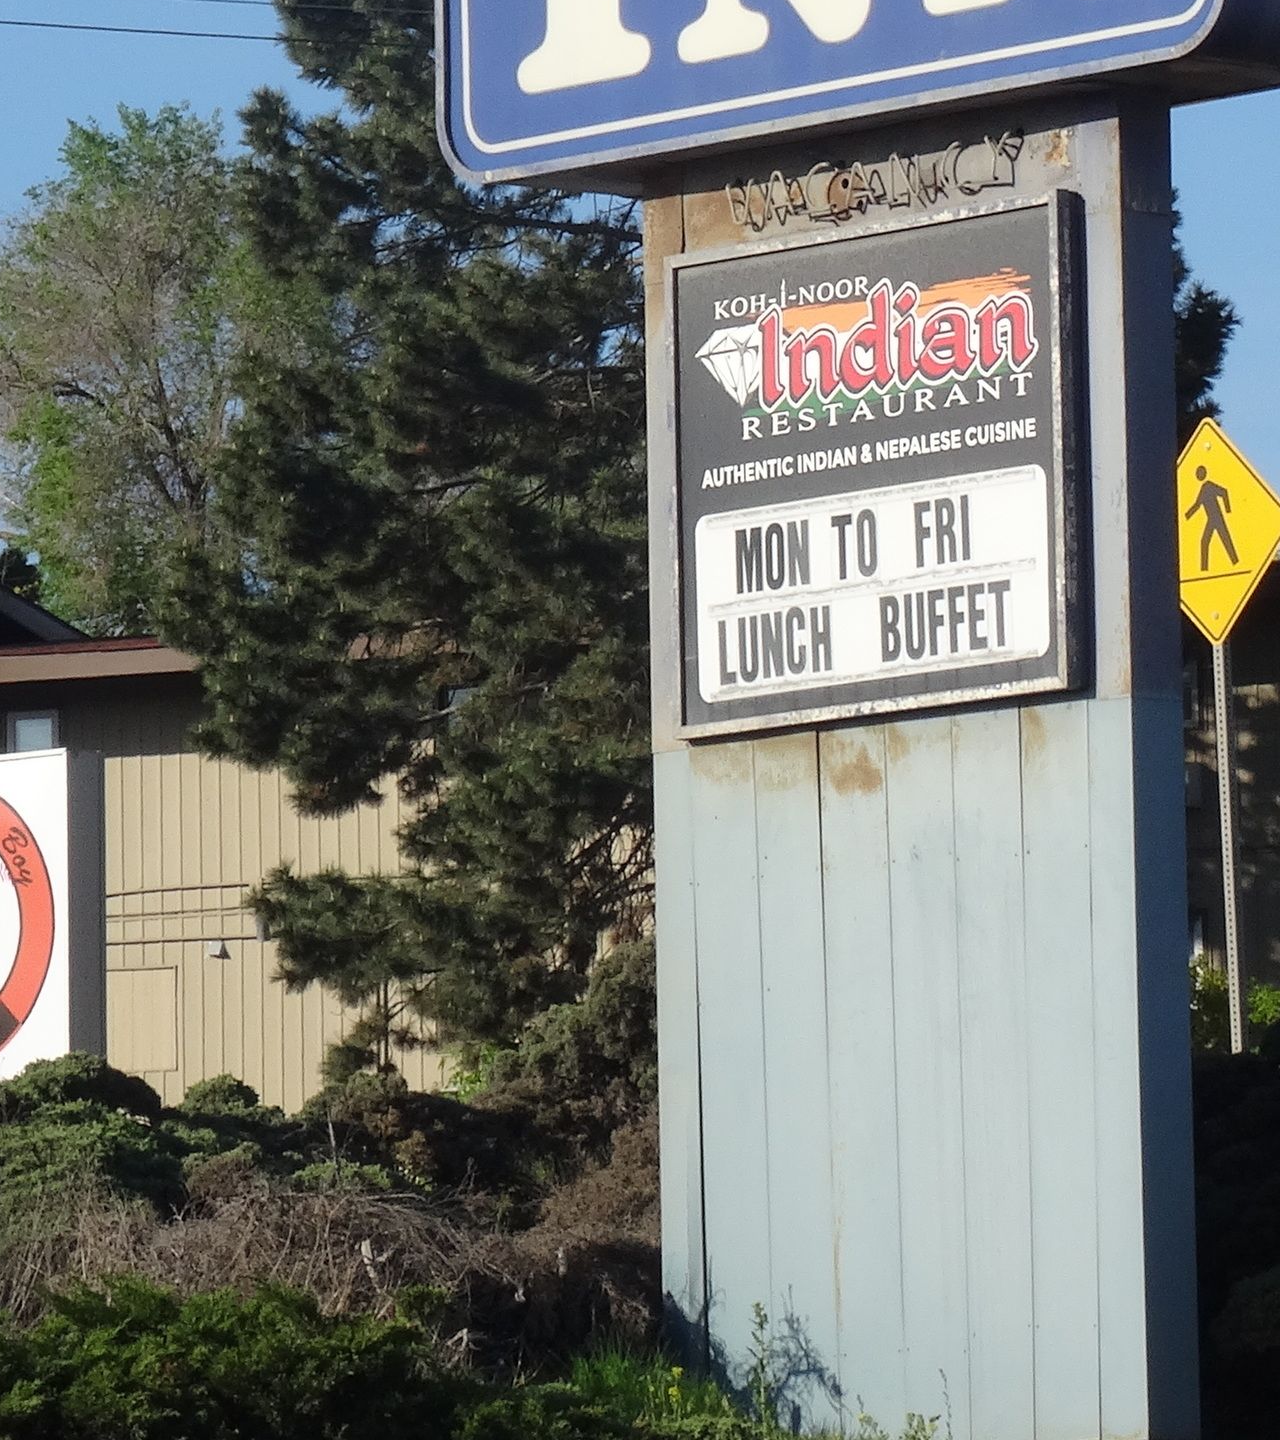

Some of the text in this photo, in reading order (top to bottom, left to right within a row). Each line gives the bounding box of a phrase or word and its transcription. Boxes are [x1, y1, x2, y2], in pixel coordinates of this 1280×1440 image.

[756, 278, 1039, 413] Indian
[741, 372, 1034, 440] RESTAURANT
[701, 417, 1037, 490] AUTHENTIC INDIAN & NEPALESE CUISINE
[735, 495, 971, 594] MON TO FRI
[718, 580, 1011, 686] LUNCH BUFFET
[1, 824, 33, 888] Boy
